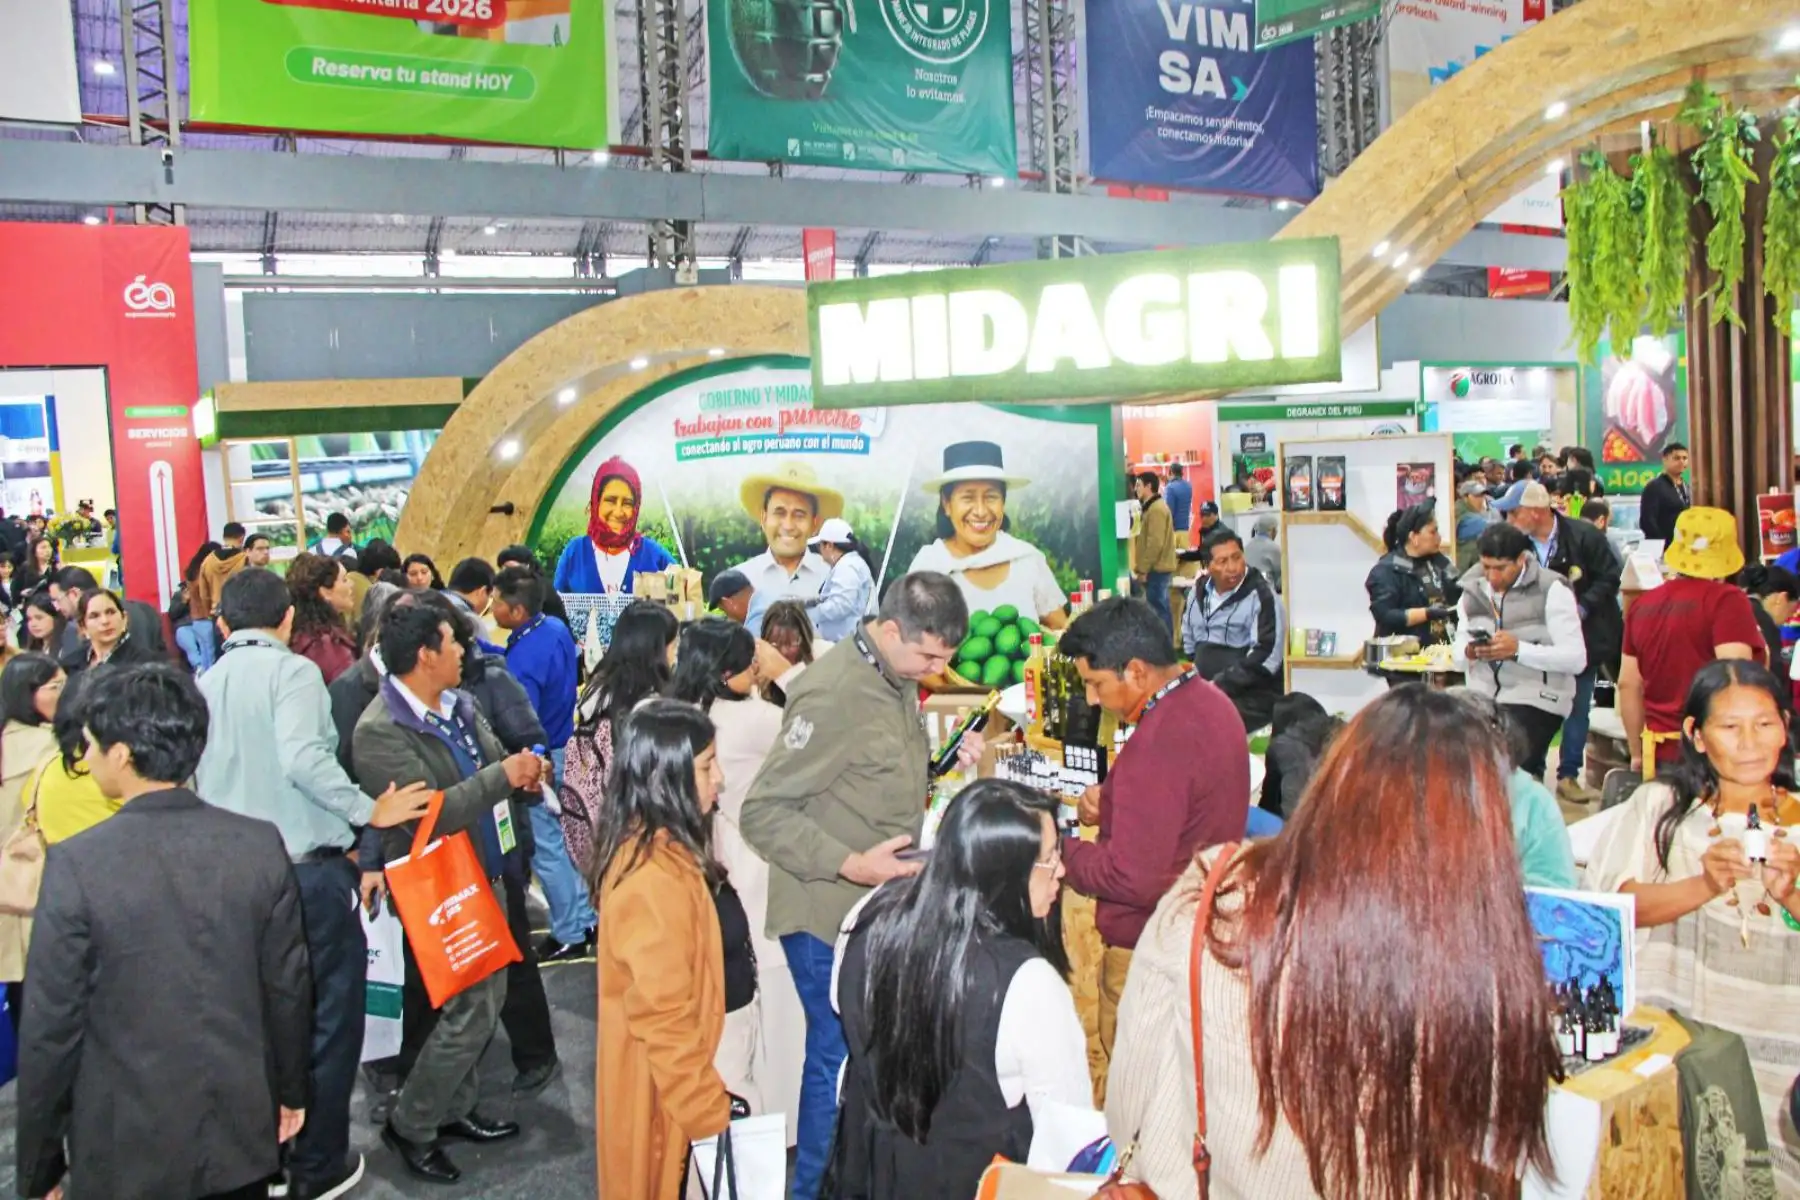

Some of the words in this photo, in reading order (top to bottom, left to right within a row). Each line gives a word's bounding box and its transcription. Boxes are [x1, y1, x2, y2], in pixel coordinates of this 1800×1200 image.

[426, 0, 493, 20] 2026
[1158, 0, 1250, 52] VIM
[911, 30, 951, 51] INTEGRADO
[951, 35, 962, 48] DE
[311, 56, 393, 81] Reserva
[396, 65, 415, 83] tu
[420, 68, 471, 88] stand
[475, 73, 514, 92] HOY
[914, 68, 958, 85] Nosotros
[1158, 50, 1228, 100] SA
[906, 84, 916, 98] lo
[1145, 105, 1203, 126] ¡Empacamos
[1157, 126, 1214, 143] conectamos
[817, 264, 1321, 386] MIDAGRI
[698, 386, 762, 409] GOBIERNO
[764, 386, 774, 403] Y
[1328, 407, 1342, 416] DEL
[127, 427, 188, 439] SERVICIOS
[673, 413, 743, 438] trabajan
[746, 414, 774, 431] con
[681, 437, 731, 455] conectando
[743, 439, 762, 453] agro
[764, 438, 801, 453] peruano
[803, 437, 819, 449] con
[821, 433, 830, 449] el
[832, 436, 865, 450] mundo
